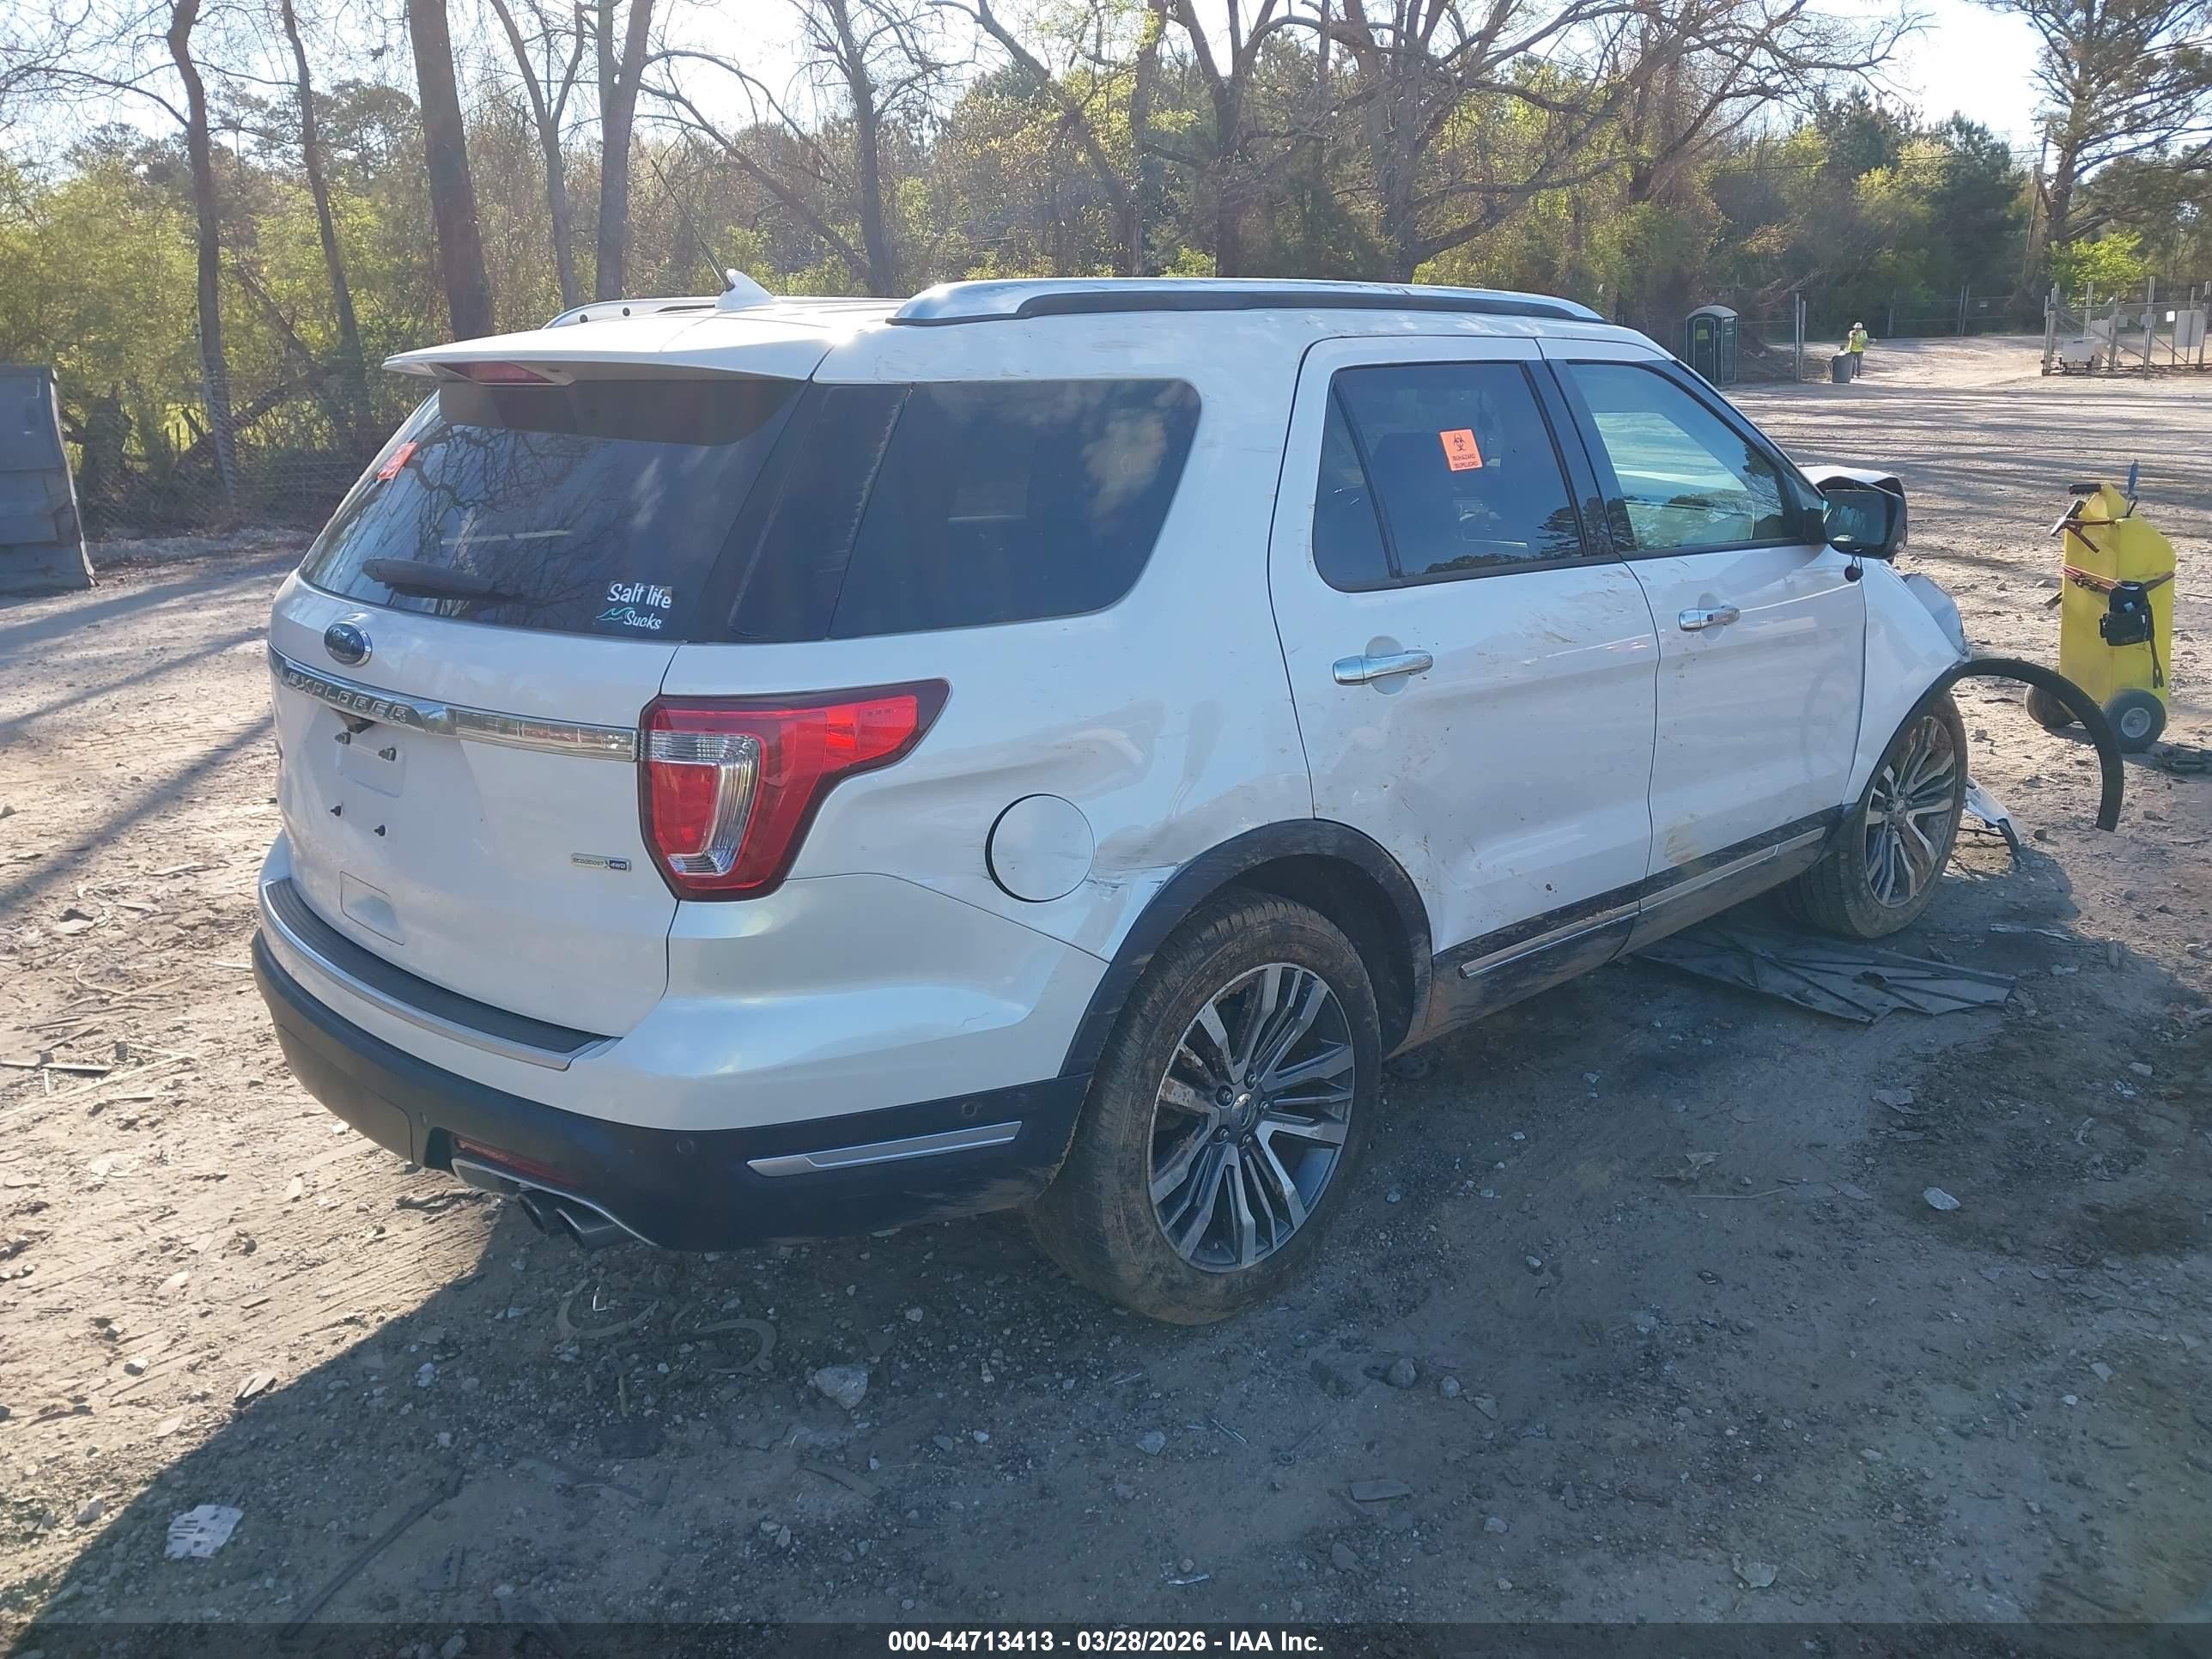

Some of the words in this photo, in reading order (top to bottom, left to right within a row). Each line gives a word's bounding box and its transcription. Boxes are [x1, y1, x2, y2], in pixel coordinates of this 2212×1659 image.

[607, 582, 644, 603] Salt
[646, 585, 672, 609] life
[623, 611, 662, 629] Sucks
[288, 672, 408, 723] EXPLORER
